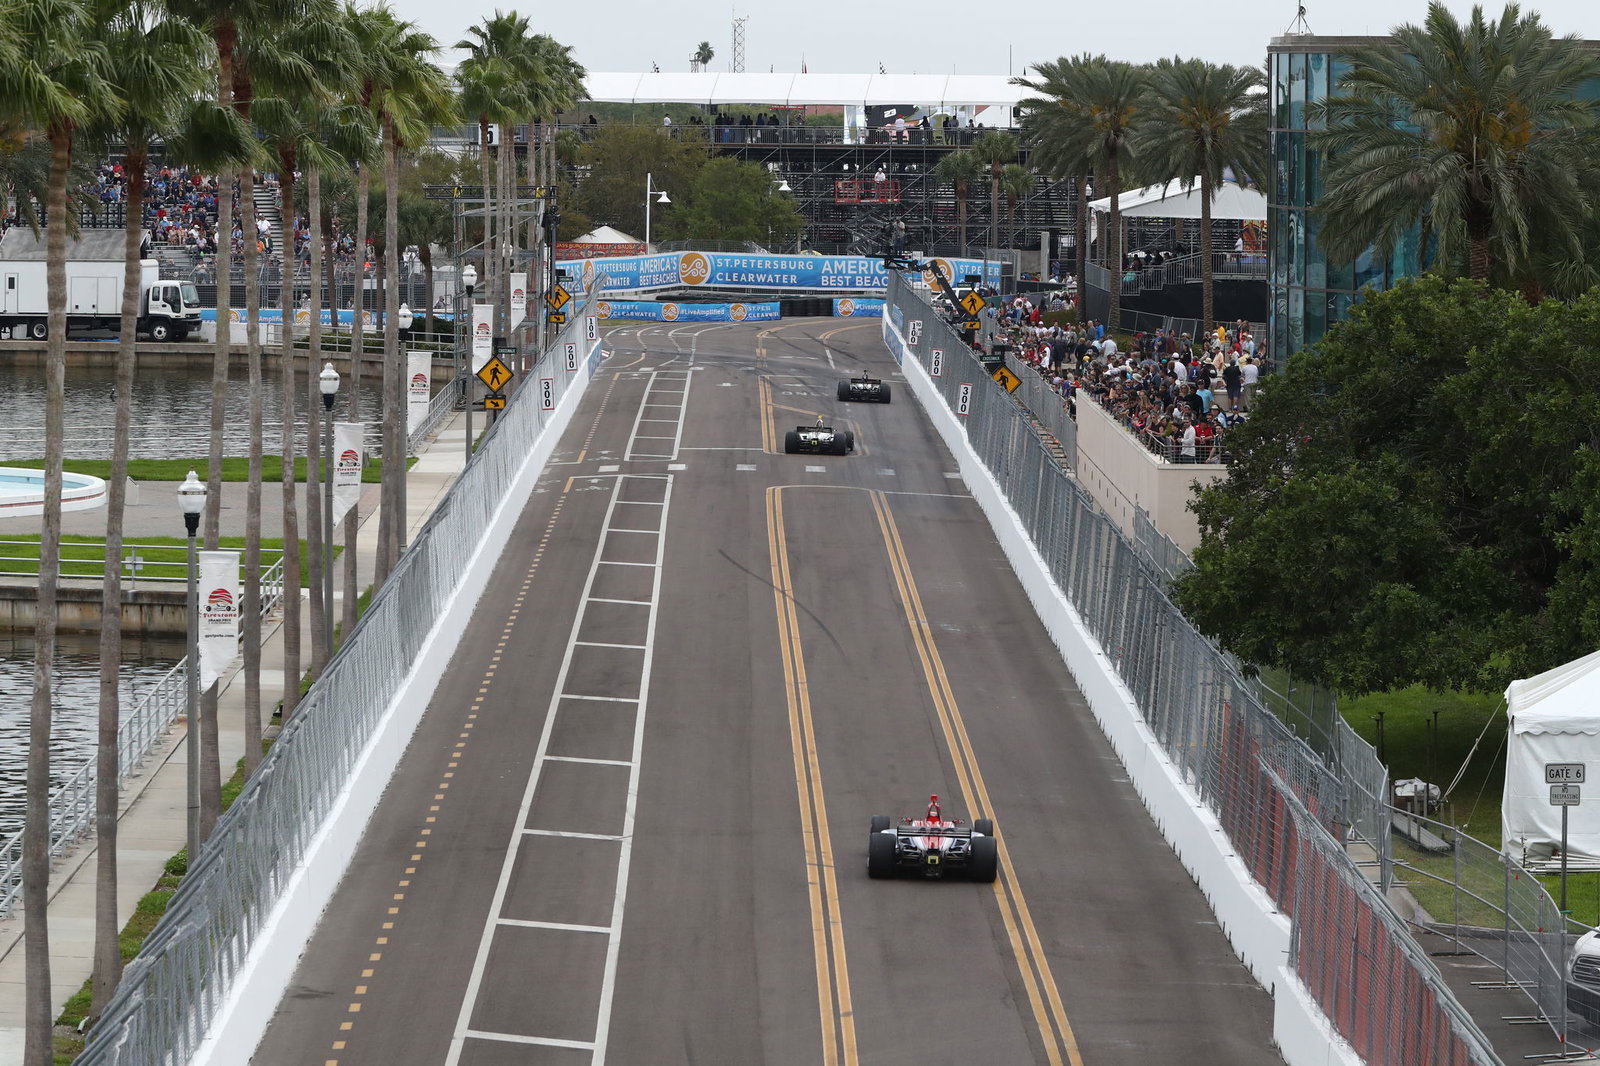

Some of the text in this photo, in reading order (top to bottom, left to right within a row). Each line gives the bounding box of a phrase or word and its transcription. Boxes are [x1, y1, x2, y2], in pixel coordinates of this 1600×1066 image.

[640, 256, 677, 273] AMERICA'S
[716, 258, 814, 270] ST.PETERSBURG
[821, 260, 889, 274] AMERIC
[640, 272, 677, 286] BEST BEACHES
[716, 272, 798, 284] CLEARWATER
[821, 276, 852, 286] BEST
[1549, 769, 1582, 778] GATE 6
